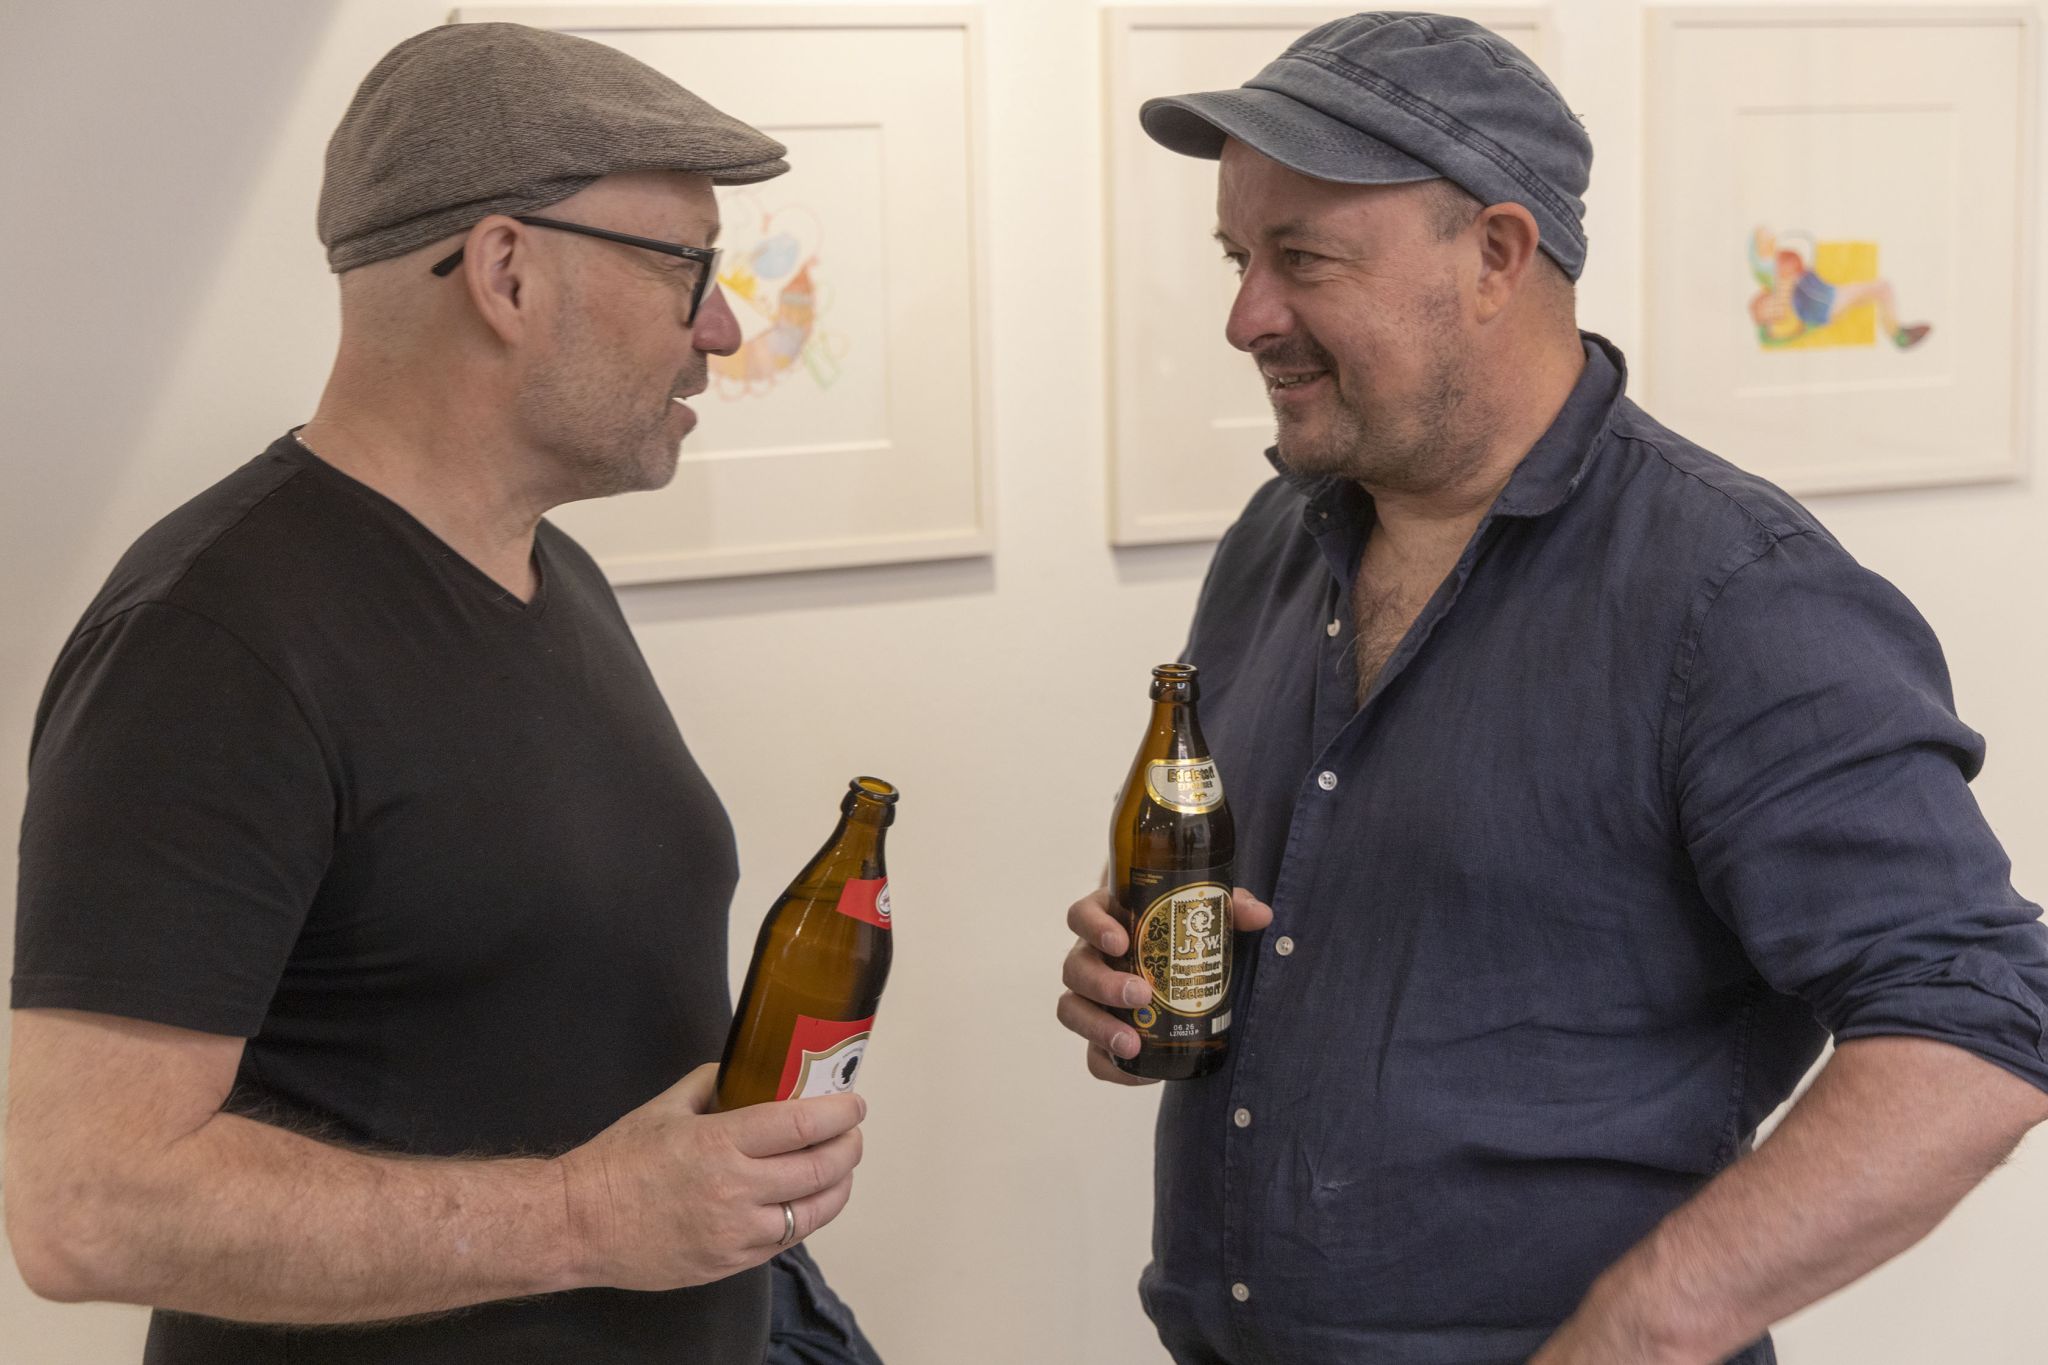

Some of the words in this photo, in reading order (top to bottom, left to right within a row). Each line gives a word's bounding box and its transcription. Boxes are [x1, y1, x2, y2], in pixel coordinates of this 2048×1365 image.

[1178, 903, 1187, 914] 13
[1177, 939, 1195, 954] J.
[1171, 982, 1221, 1001] Edelstoff
